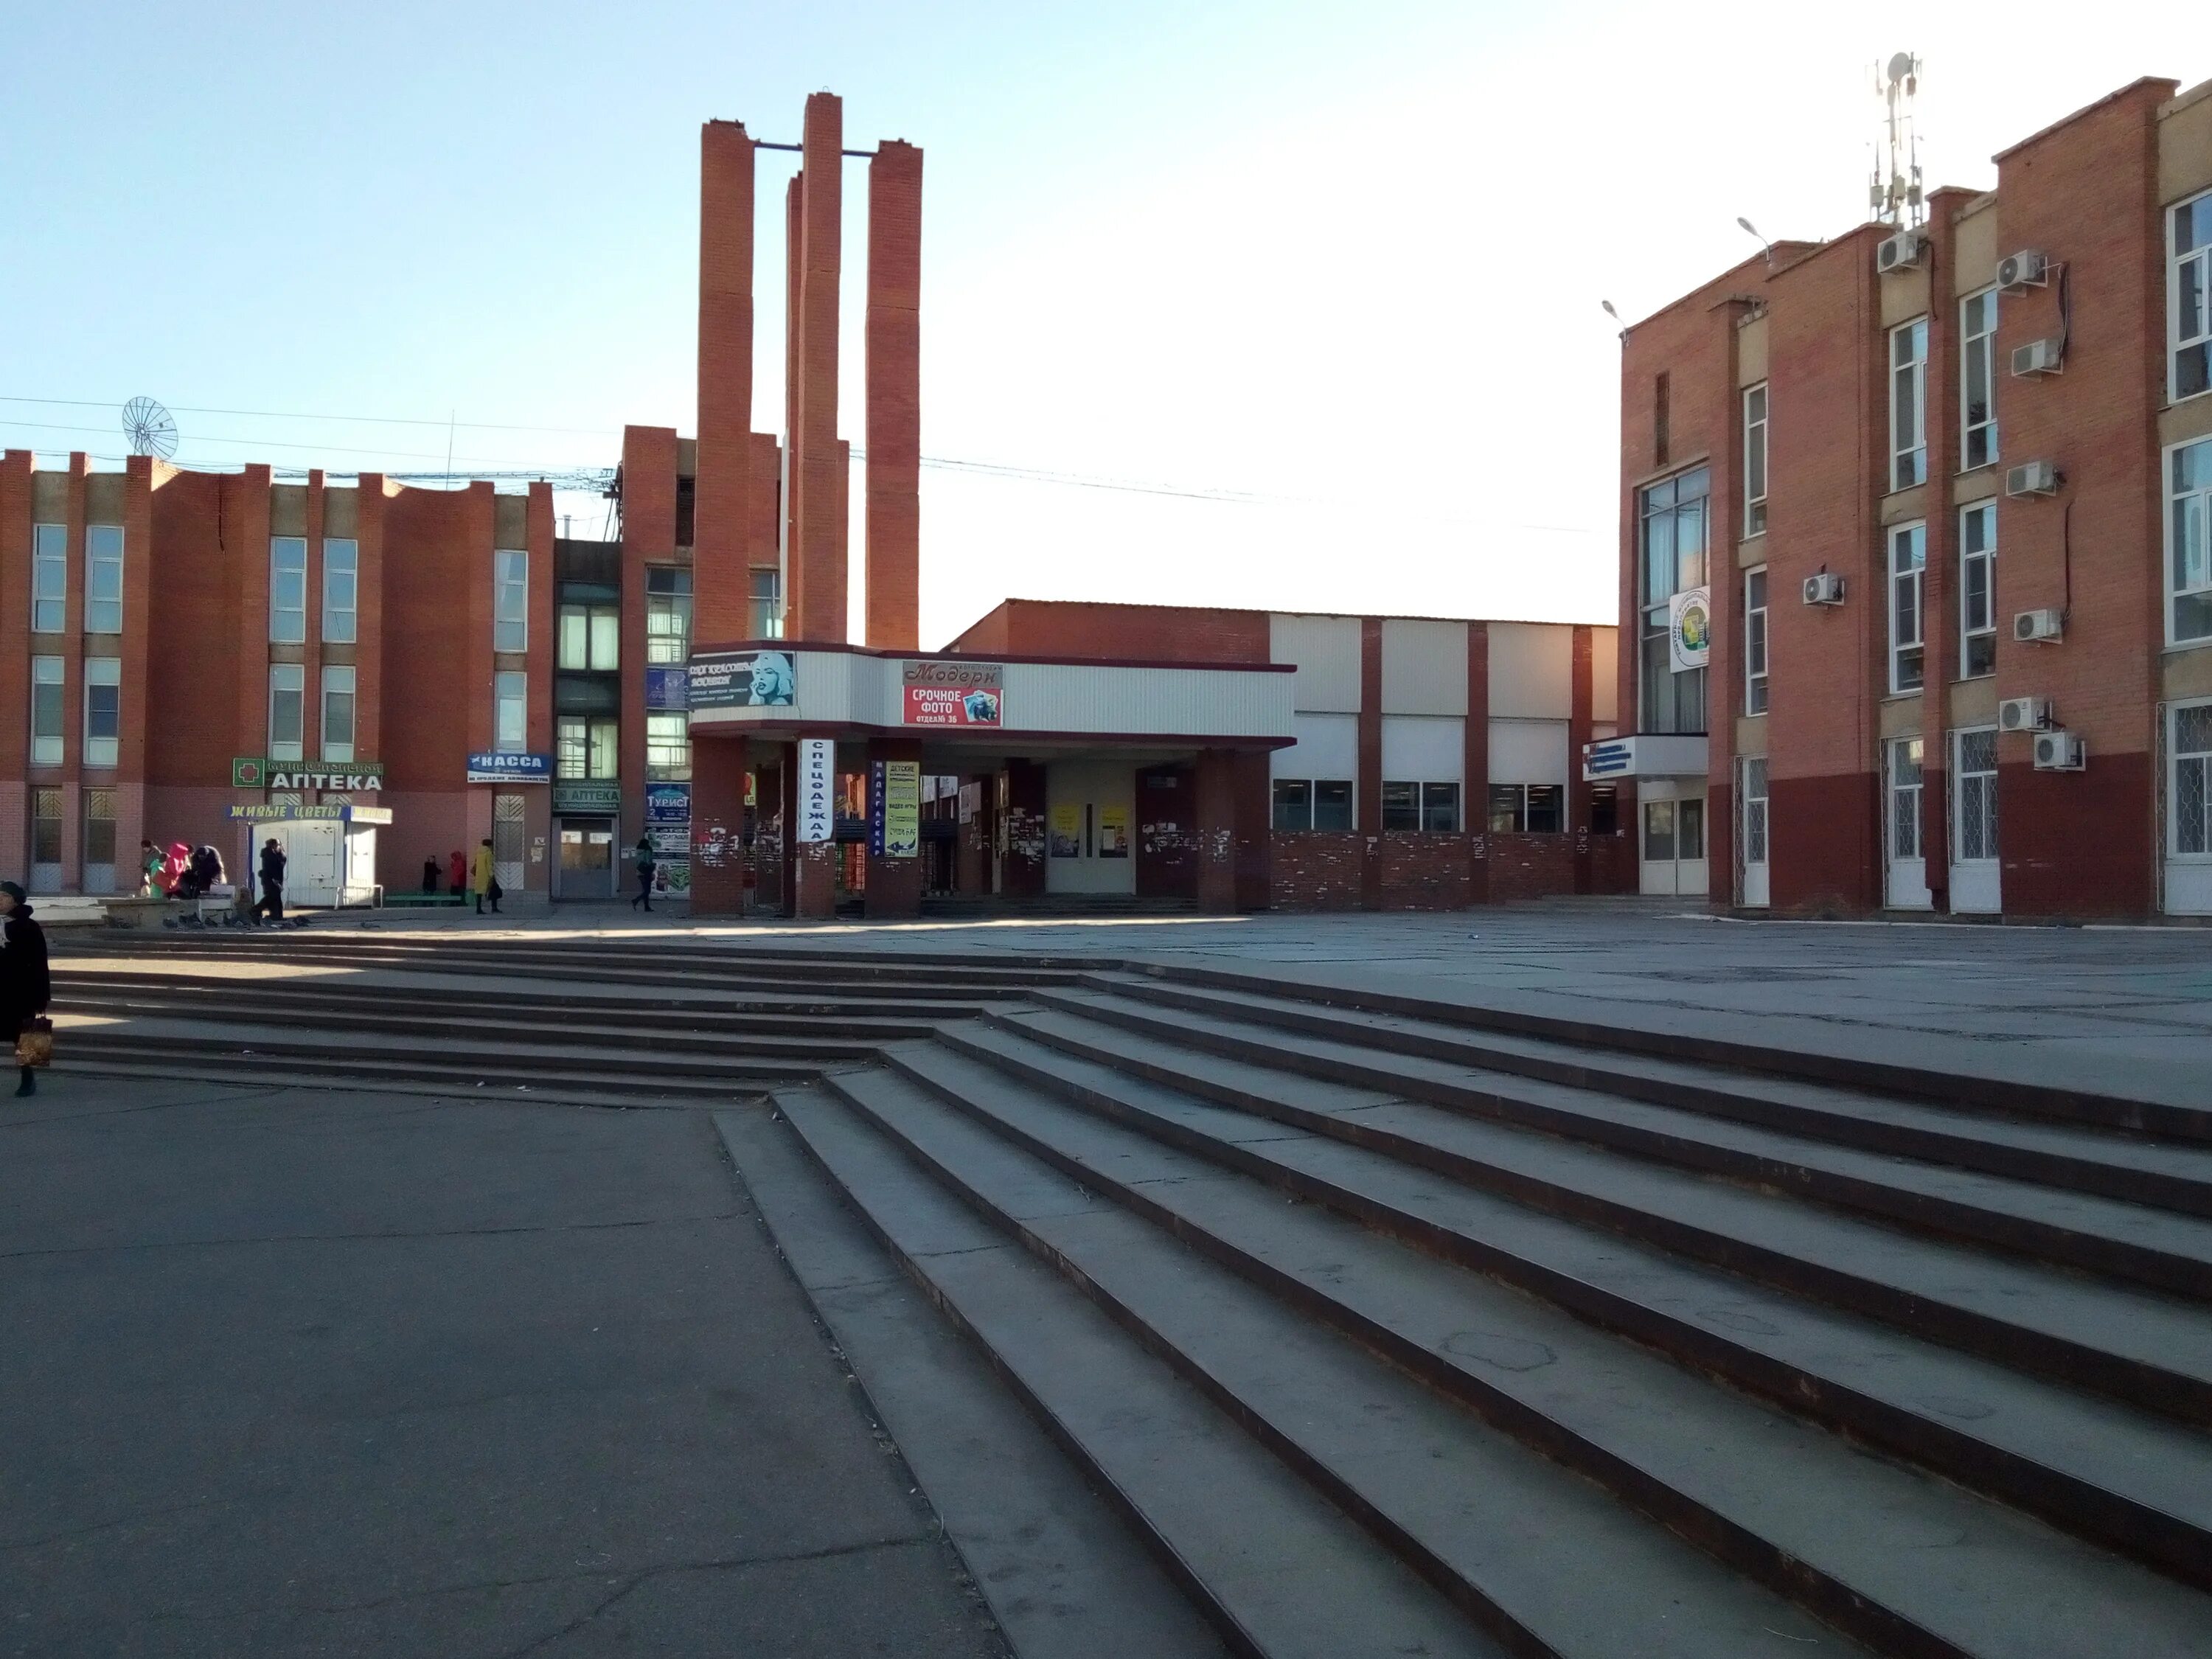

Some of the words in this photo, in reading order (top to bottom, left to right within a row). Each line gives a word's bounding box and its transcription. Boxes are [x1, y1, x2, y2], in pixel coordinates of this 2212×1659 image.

[905, 663, 996, 688] Модерн
[913, 689, 961, 702] СРОЧНОЕ
[921, 702, 953, 714] ФОТО
[948, 715, 957, 723] 36
[481, 756, 542, 768] КАССА
[271, 773, 382, 790] АПТЕКА
[571, 790, 619, 801] АПТЕКА
[808, 742, 826, 839] СПЕЦОДЕЖДА
[647, 796, 689, 807] ТУРИСТ
[230, 805, 287, 818] ЖИВЫЕ
[294, 806, 341, 819] ЦВЕТЫ
[650, 808, 655, 816] 2
[874, 762, 883, 855] МАДАГАСКАР
